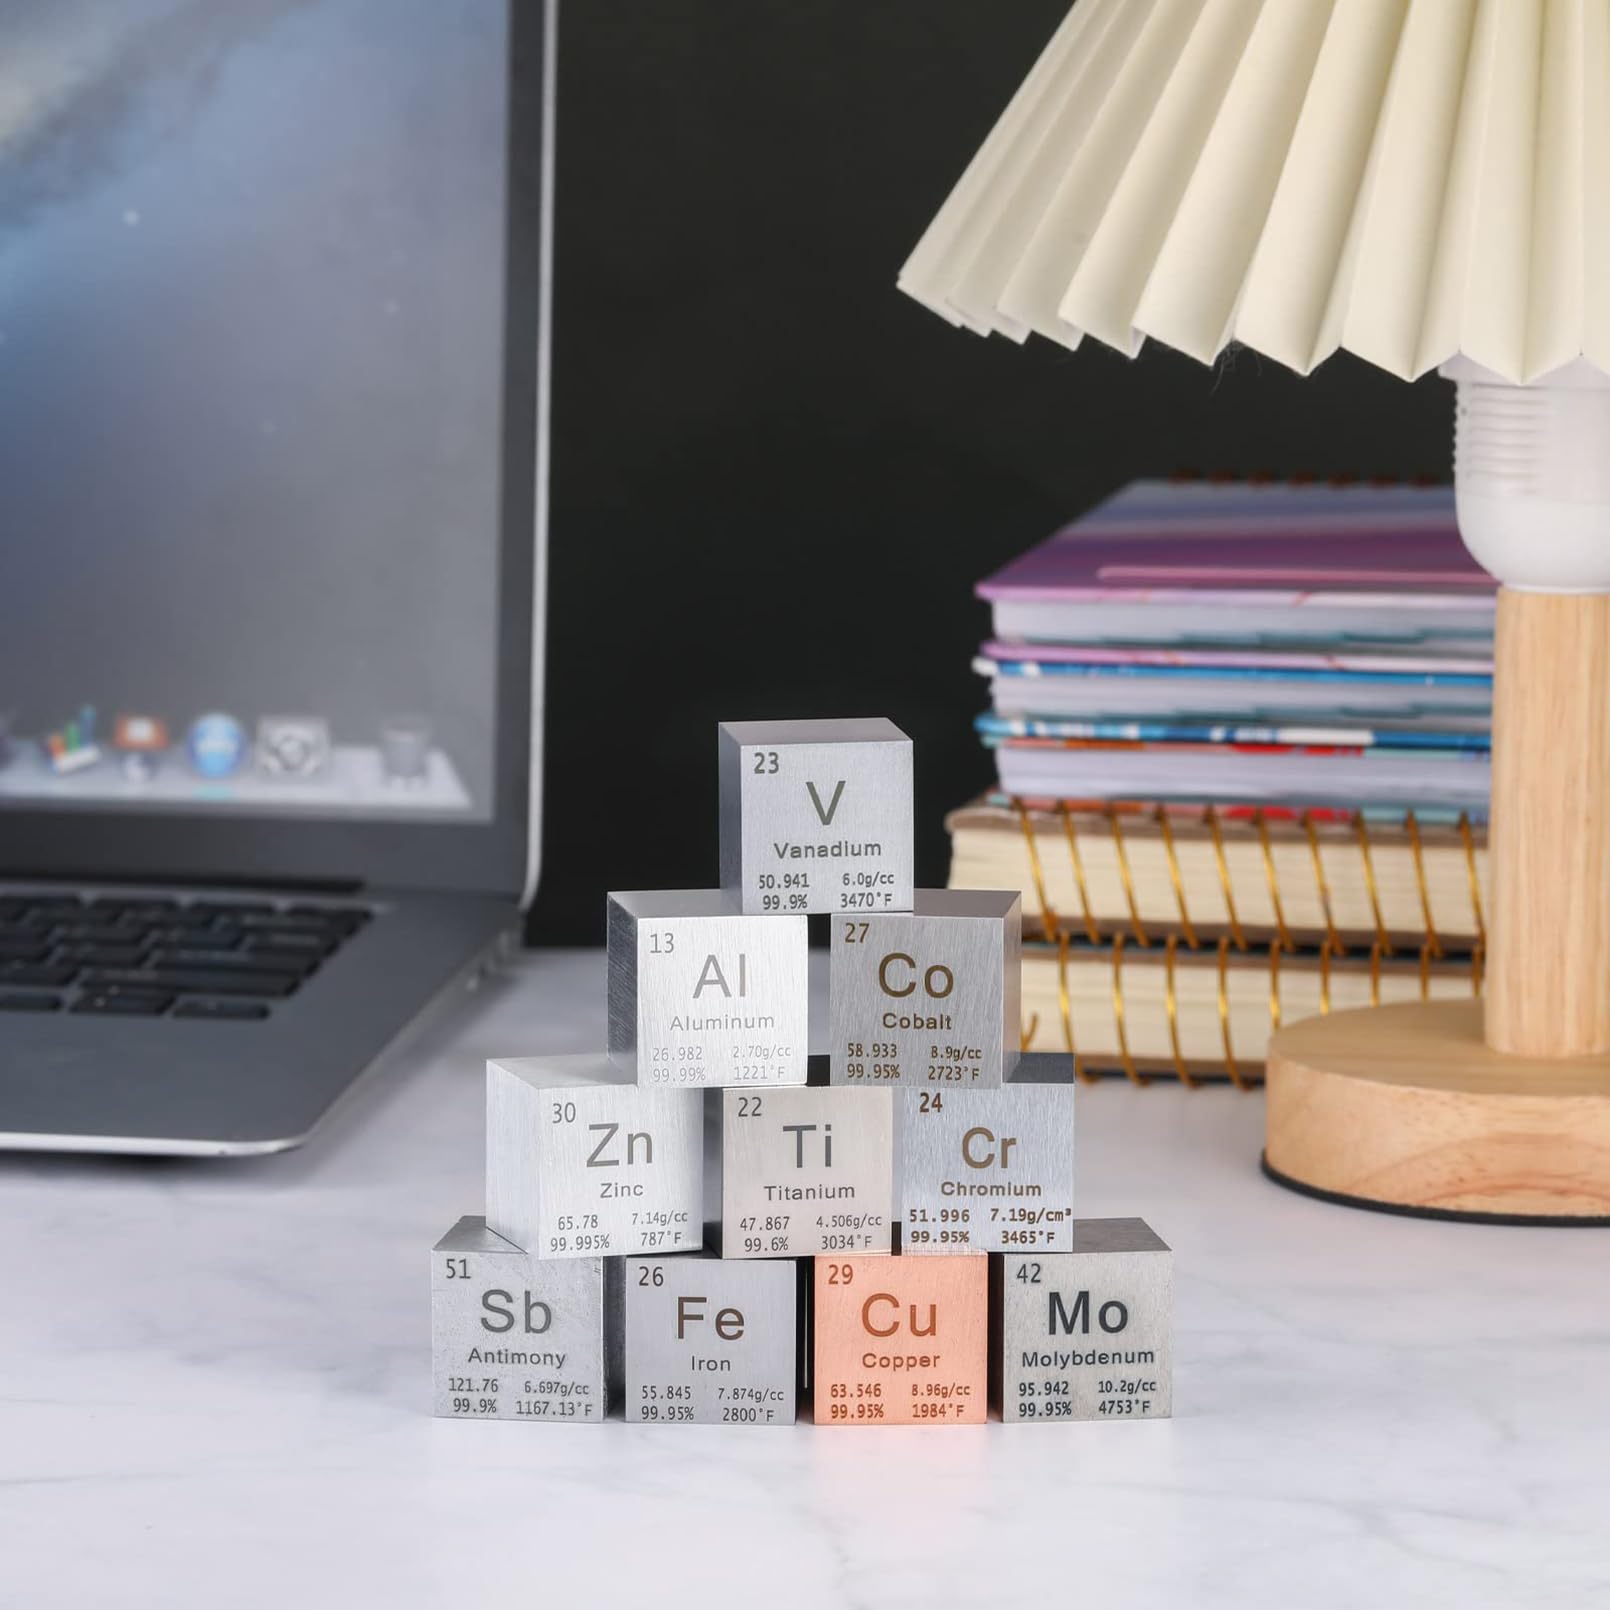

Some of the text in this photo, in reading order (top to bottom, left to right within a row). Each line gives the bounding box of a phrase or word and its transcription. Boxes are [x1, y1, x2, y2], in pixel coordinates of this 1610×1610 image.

[754, 752, 779, 774] 23
[806, 781, 846, 825] V
[774, 841, 882, 859] Vanadium
[759, 872, 894, 889] 50.941 6.0g/cc
[763, 894, 807, 910] 99.9%
[845, 923, 870, 943] 27
[650, 933, 674, 953] 13
[692, 954, 746, 999] Al
[879, 953, 954, 998] Co
[670, 1015, 774, 1031] Aluminum
[883, 1013, 952, 1030] Cobalt
[653, 1044, 791, 1061] 26.982 2.70g/cc
[848, 1043, 982, 1062] 58.933 8.9g/cc
[653, 1067, 705, 1082] 99.99%
[847, 1064, 900, 1079] 99.95%
[738, 1097, 762, 1117] 22
[919, 1092, 943, 1112] 24
[552, 1102, 576, 1123] 30
[586, 1123, 652, 1167] Zn
[783, 1124, 831, 1168] Ti
[962, 1127, 1016, 1169] Cr
[600, 1182, 644, 1198] Zinc
[764, 1184, 855, 1201] Titanium
[941, 1181, 1041, 1196] Chromium
[558, 1210, 688, 1230] 65.78 7.14g/cc
[740, 1214, 882, 1231] 47.867 4.506g/cc
[910, 1209, 970, 1223] 51.996
[551, 1234, 610, 1252] 99.995%
[744, 1237, 789, 1252] 99.6%
[911, 1231, 969, 1243] 99.95%
[446, 1258, 471, 1279] 51
[639, 1266, 664, 1286] 26
[828, 1264, 853, 1285] 29
[1017, 1263, 1041, 1283] 42
[480, 1289, 551, 1333] Sb
[678, 1297, 745, 1340] Fe
[862, 1293, 937, 1337] Cu
[1049, 1291, 1128, 1335] Mo
[468, 1348, 566, 1369] Antimony
[691, 1356, 731, 1371] Iron
[862, 1353, 940, 1371] Copper
[1022, 1350, 1154, 1370] Molybdenum
[448, 1377, 589, 1397] 121.76 6.697g/cc
[642, 1386, 784, 1403] 55.845 7.874g/cc
[831, 1382, 970, 1398] 63.546 8.96g/cc
[1019, 1379, 1157, 1396] 95.942 10.2g/cc
[453, 1398, 496, 1413] 99.9%
[642, 1406, 694, 1420] 99.95%
[831, 1404, 884, 1419] 99.95%
[1019, 1401, 1071, 1417] 99.95%
